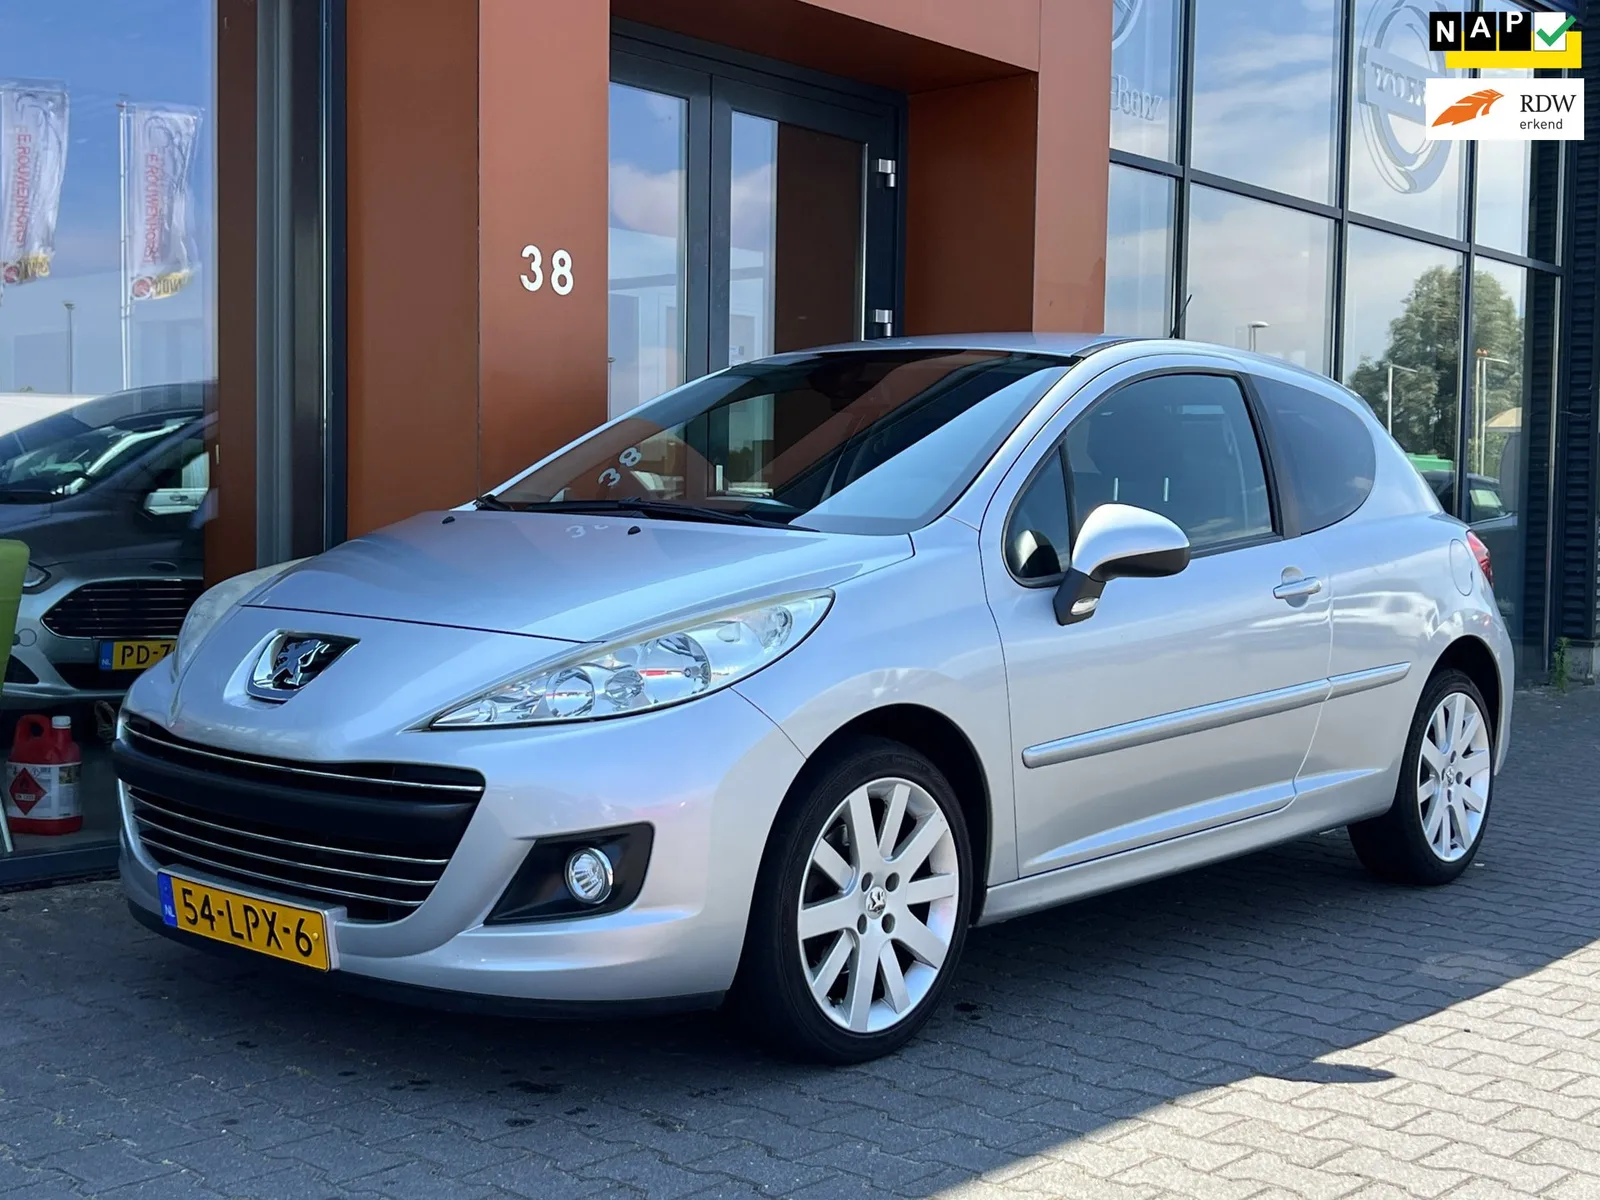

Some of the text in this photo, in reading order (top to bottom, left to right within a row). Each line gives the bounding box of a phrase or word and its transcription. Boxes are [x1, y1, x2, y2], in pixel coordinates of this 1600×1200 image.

[519, 244, 574, 296] 38
[121, 644, 176, 666] PD-7
[164, 903, 176, 918] NL
[181, 887, 313, 958] 54-LPX-6
